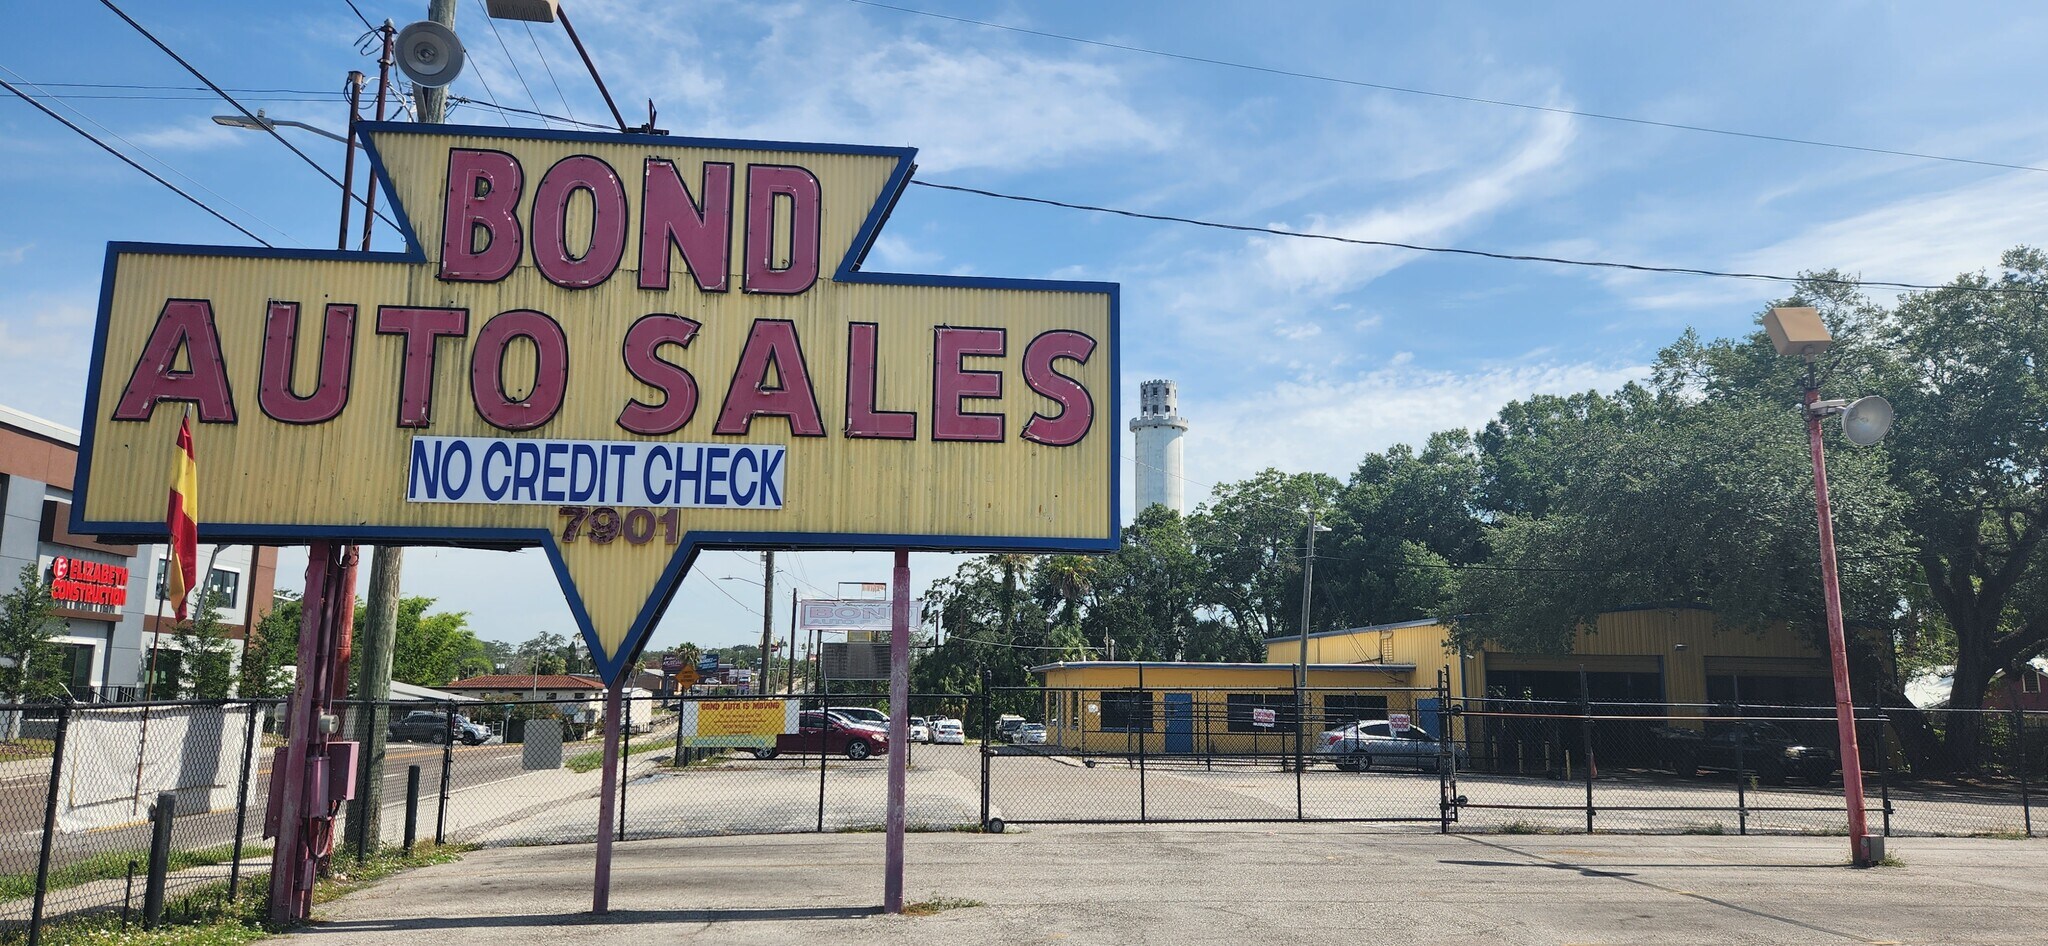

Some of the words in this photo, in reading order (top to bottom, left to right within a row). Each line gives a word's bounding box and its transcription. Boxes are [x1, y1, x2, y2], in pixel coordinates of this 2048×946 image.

[438, 147, 822, 294] BOND
[111, 298, 569, 432] AUTO
[616, 313, 1098, 446] SALES
[409, 440, 472, 500] NO
[481, 441, 636, 502] CREDIT
[643, 445, 785, 505] CHECK
[559, 507, 680, 545] 7901
[70, 558, 128, 585] ELIZABETH
[52, 579, 126, 605] CONSTRUCTION
[701, 703, 720, 711] BOND
[722, 702, 741, 710] AUTO
[742, 702, 750, 710] IS
[752, 702, 780, 710] MOVING
